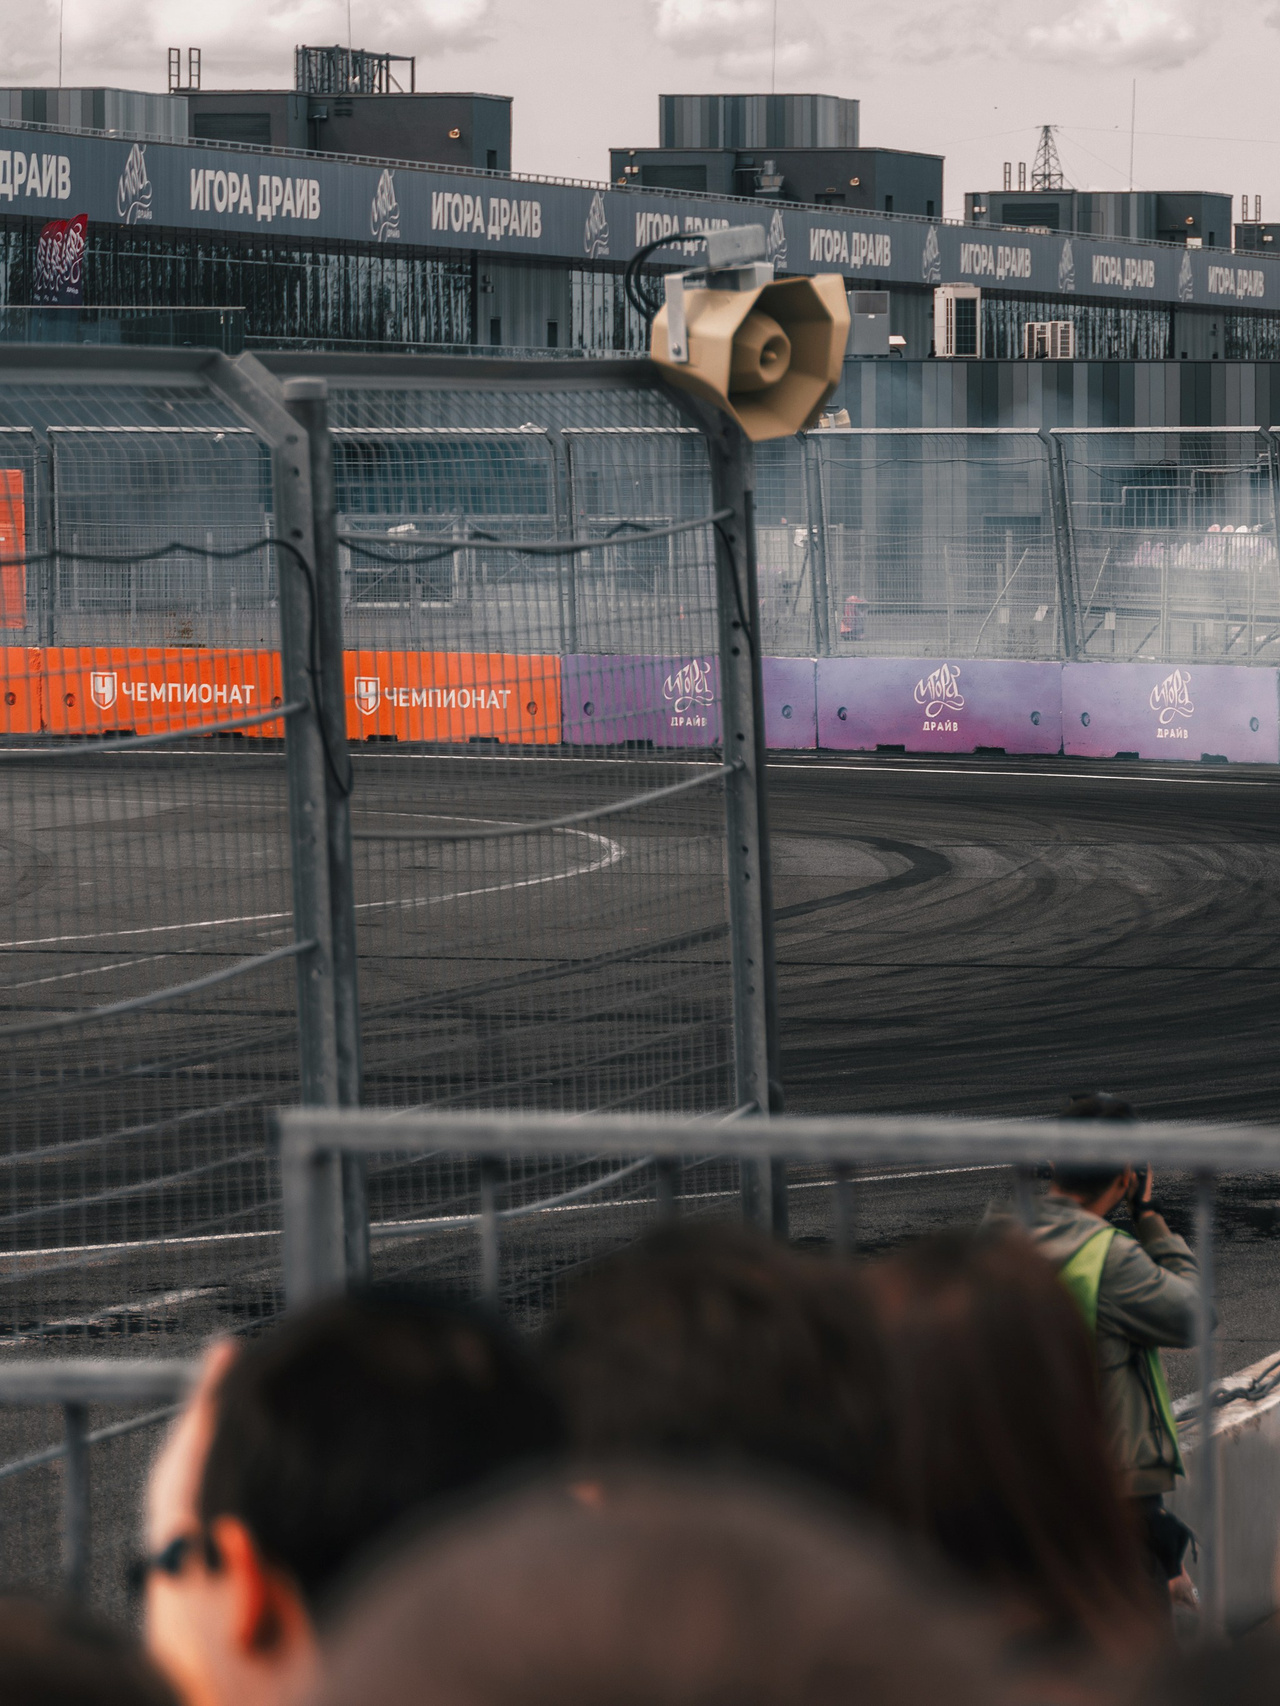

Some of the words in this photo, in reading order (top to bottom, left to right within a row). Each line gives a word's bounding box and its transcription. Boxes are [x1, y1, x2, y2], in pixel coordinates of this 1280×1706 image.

[190, 168, 253, 214] ИГОРА
[431, 191, 485, 233] ИГОРА
[635, 212, 681, 250] ИГОРА
[810, 228, 849, 263] ИГОРА
[960, 242, 995, 276] ИГОРА
[1092, 255, 1122, 285] ИГОРА
[1208, 265, 1236, 295] ИГОРА
[122, 682, 255, 704] ЧЕМПИОНАТ
[384, 687, 511, 709] ЧЕМПИОНАТ
[670, 714, 708, 727] ДРАЙВ
[922, 719, 958, 732] ДРАЙВ
[1156, 726, 1189, 739] ДРАЙВ
